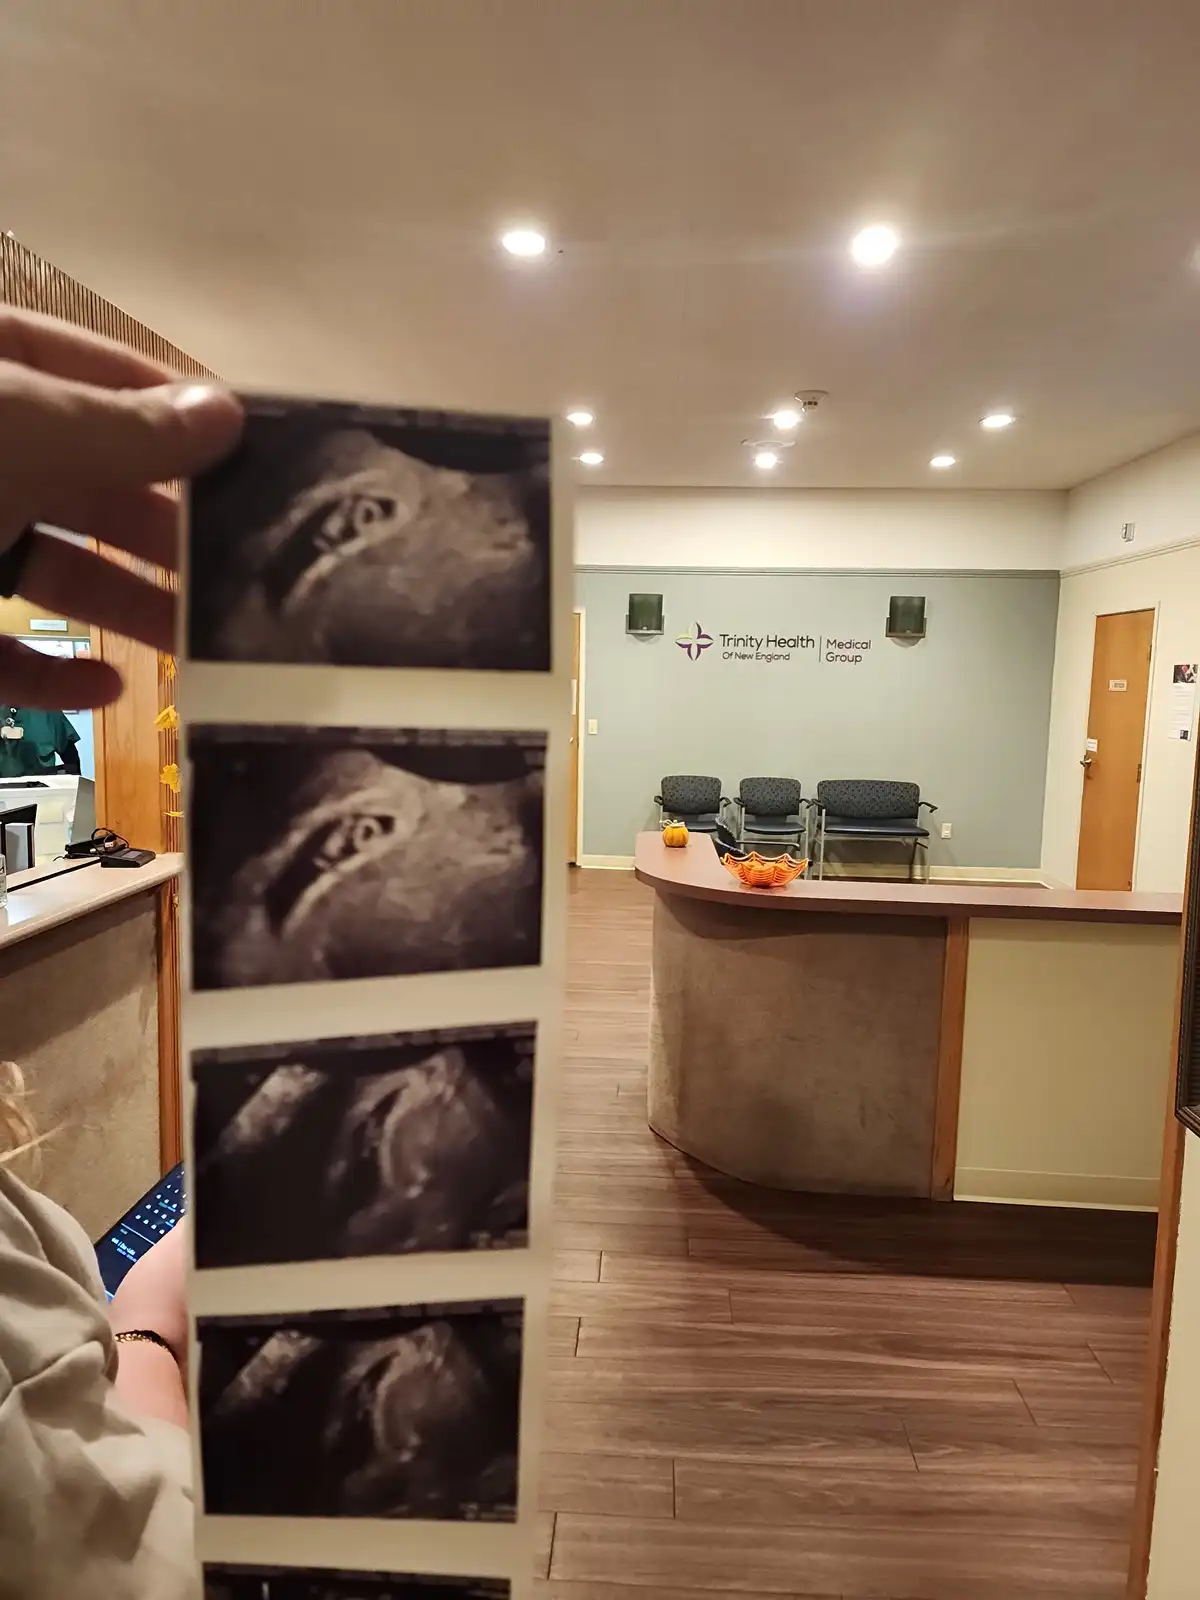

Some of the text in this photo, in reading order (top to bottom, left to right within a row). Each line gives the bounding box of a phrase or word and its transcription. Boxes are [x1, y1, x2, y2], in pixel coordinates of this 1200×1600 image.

[719, 634, 815, 651] Trinity Health
[826, 638, 872, 650] Medical
[722, 651, 791, 663] Of New England
[825, 651, 863, 665] Group
